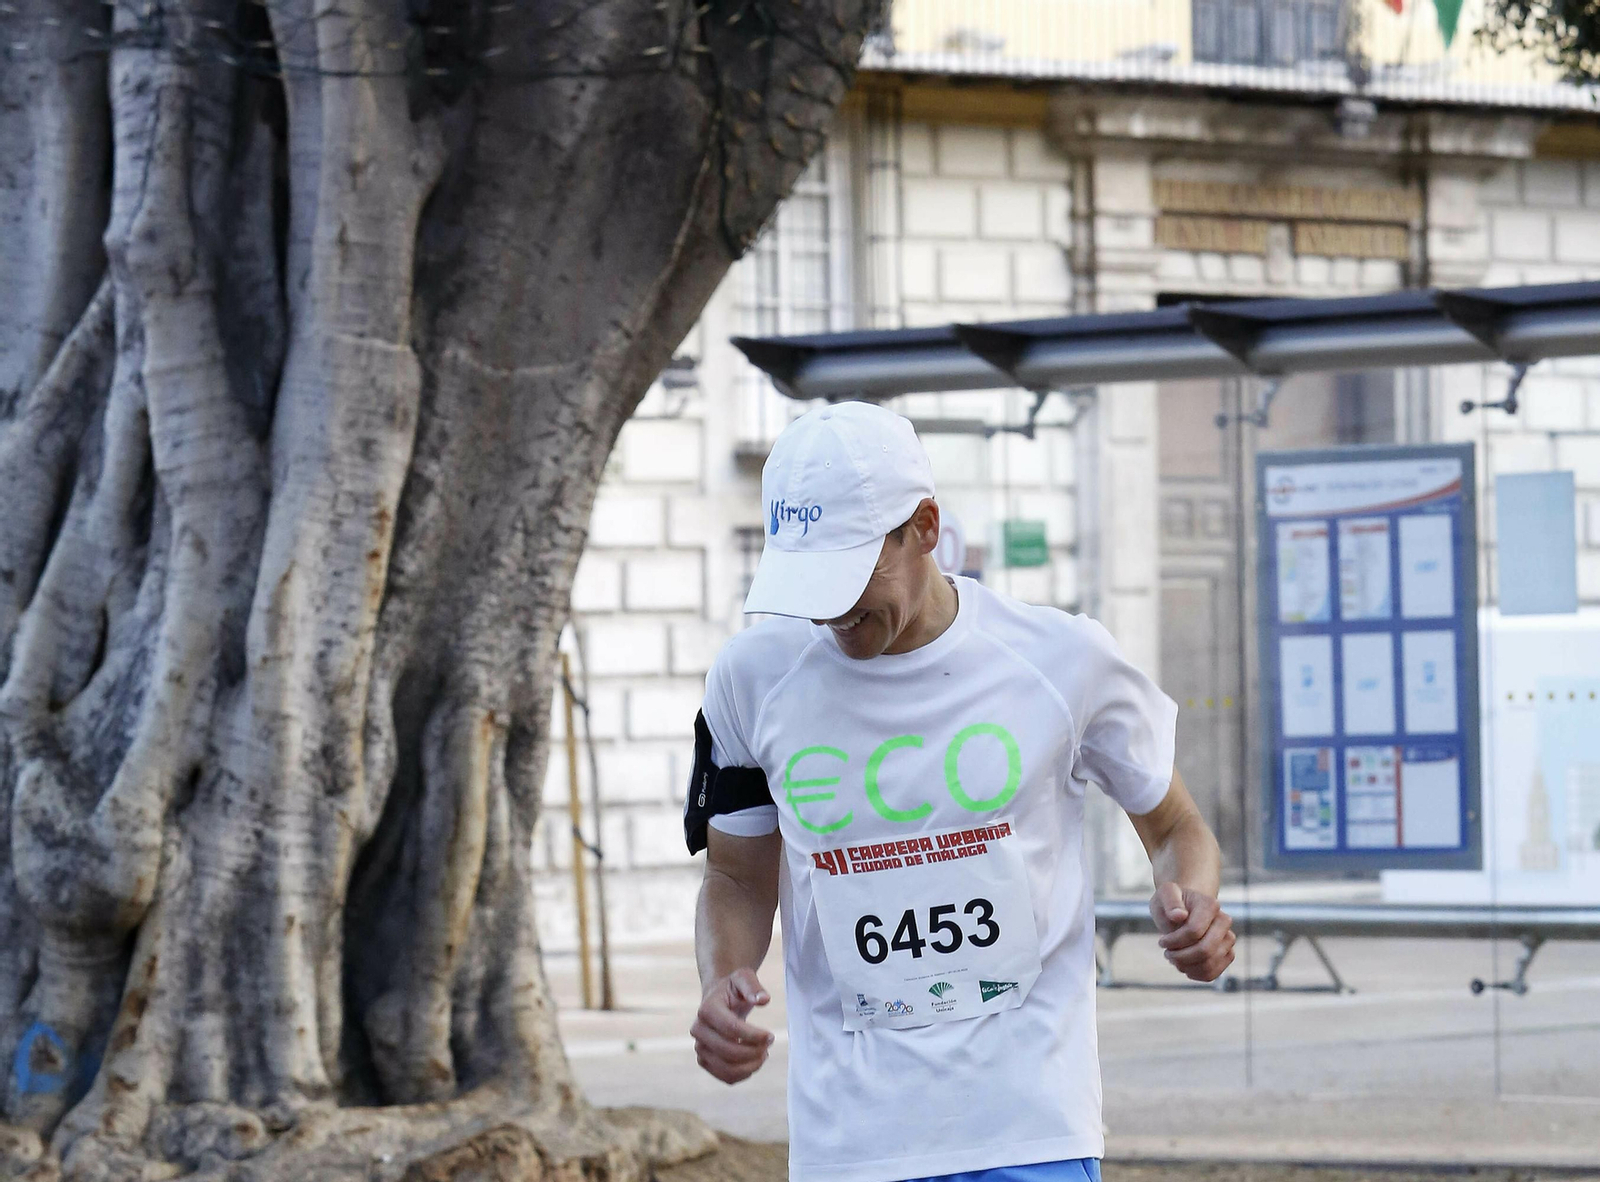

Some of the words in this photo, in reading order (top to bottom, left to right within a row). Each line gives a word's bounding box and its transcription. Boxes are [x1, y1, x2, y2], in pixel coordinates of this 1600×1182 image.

[770, 499, 822, 537] Virgo
[811, 848, 849, 876] 41
[847, 837, 933, 862] CARRERA
[935, 822, 1013, 849] URBANA
[852, 857, 903, 874] CIUDAD
[905, 854, 924, 867] DE
[854, 898, 1001, 964] 6453
